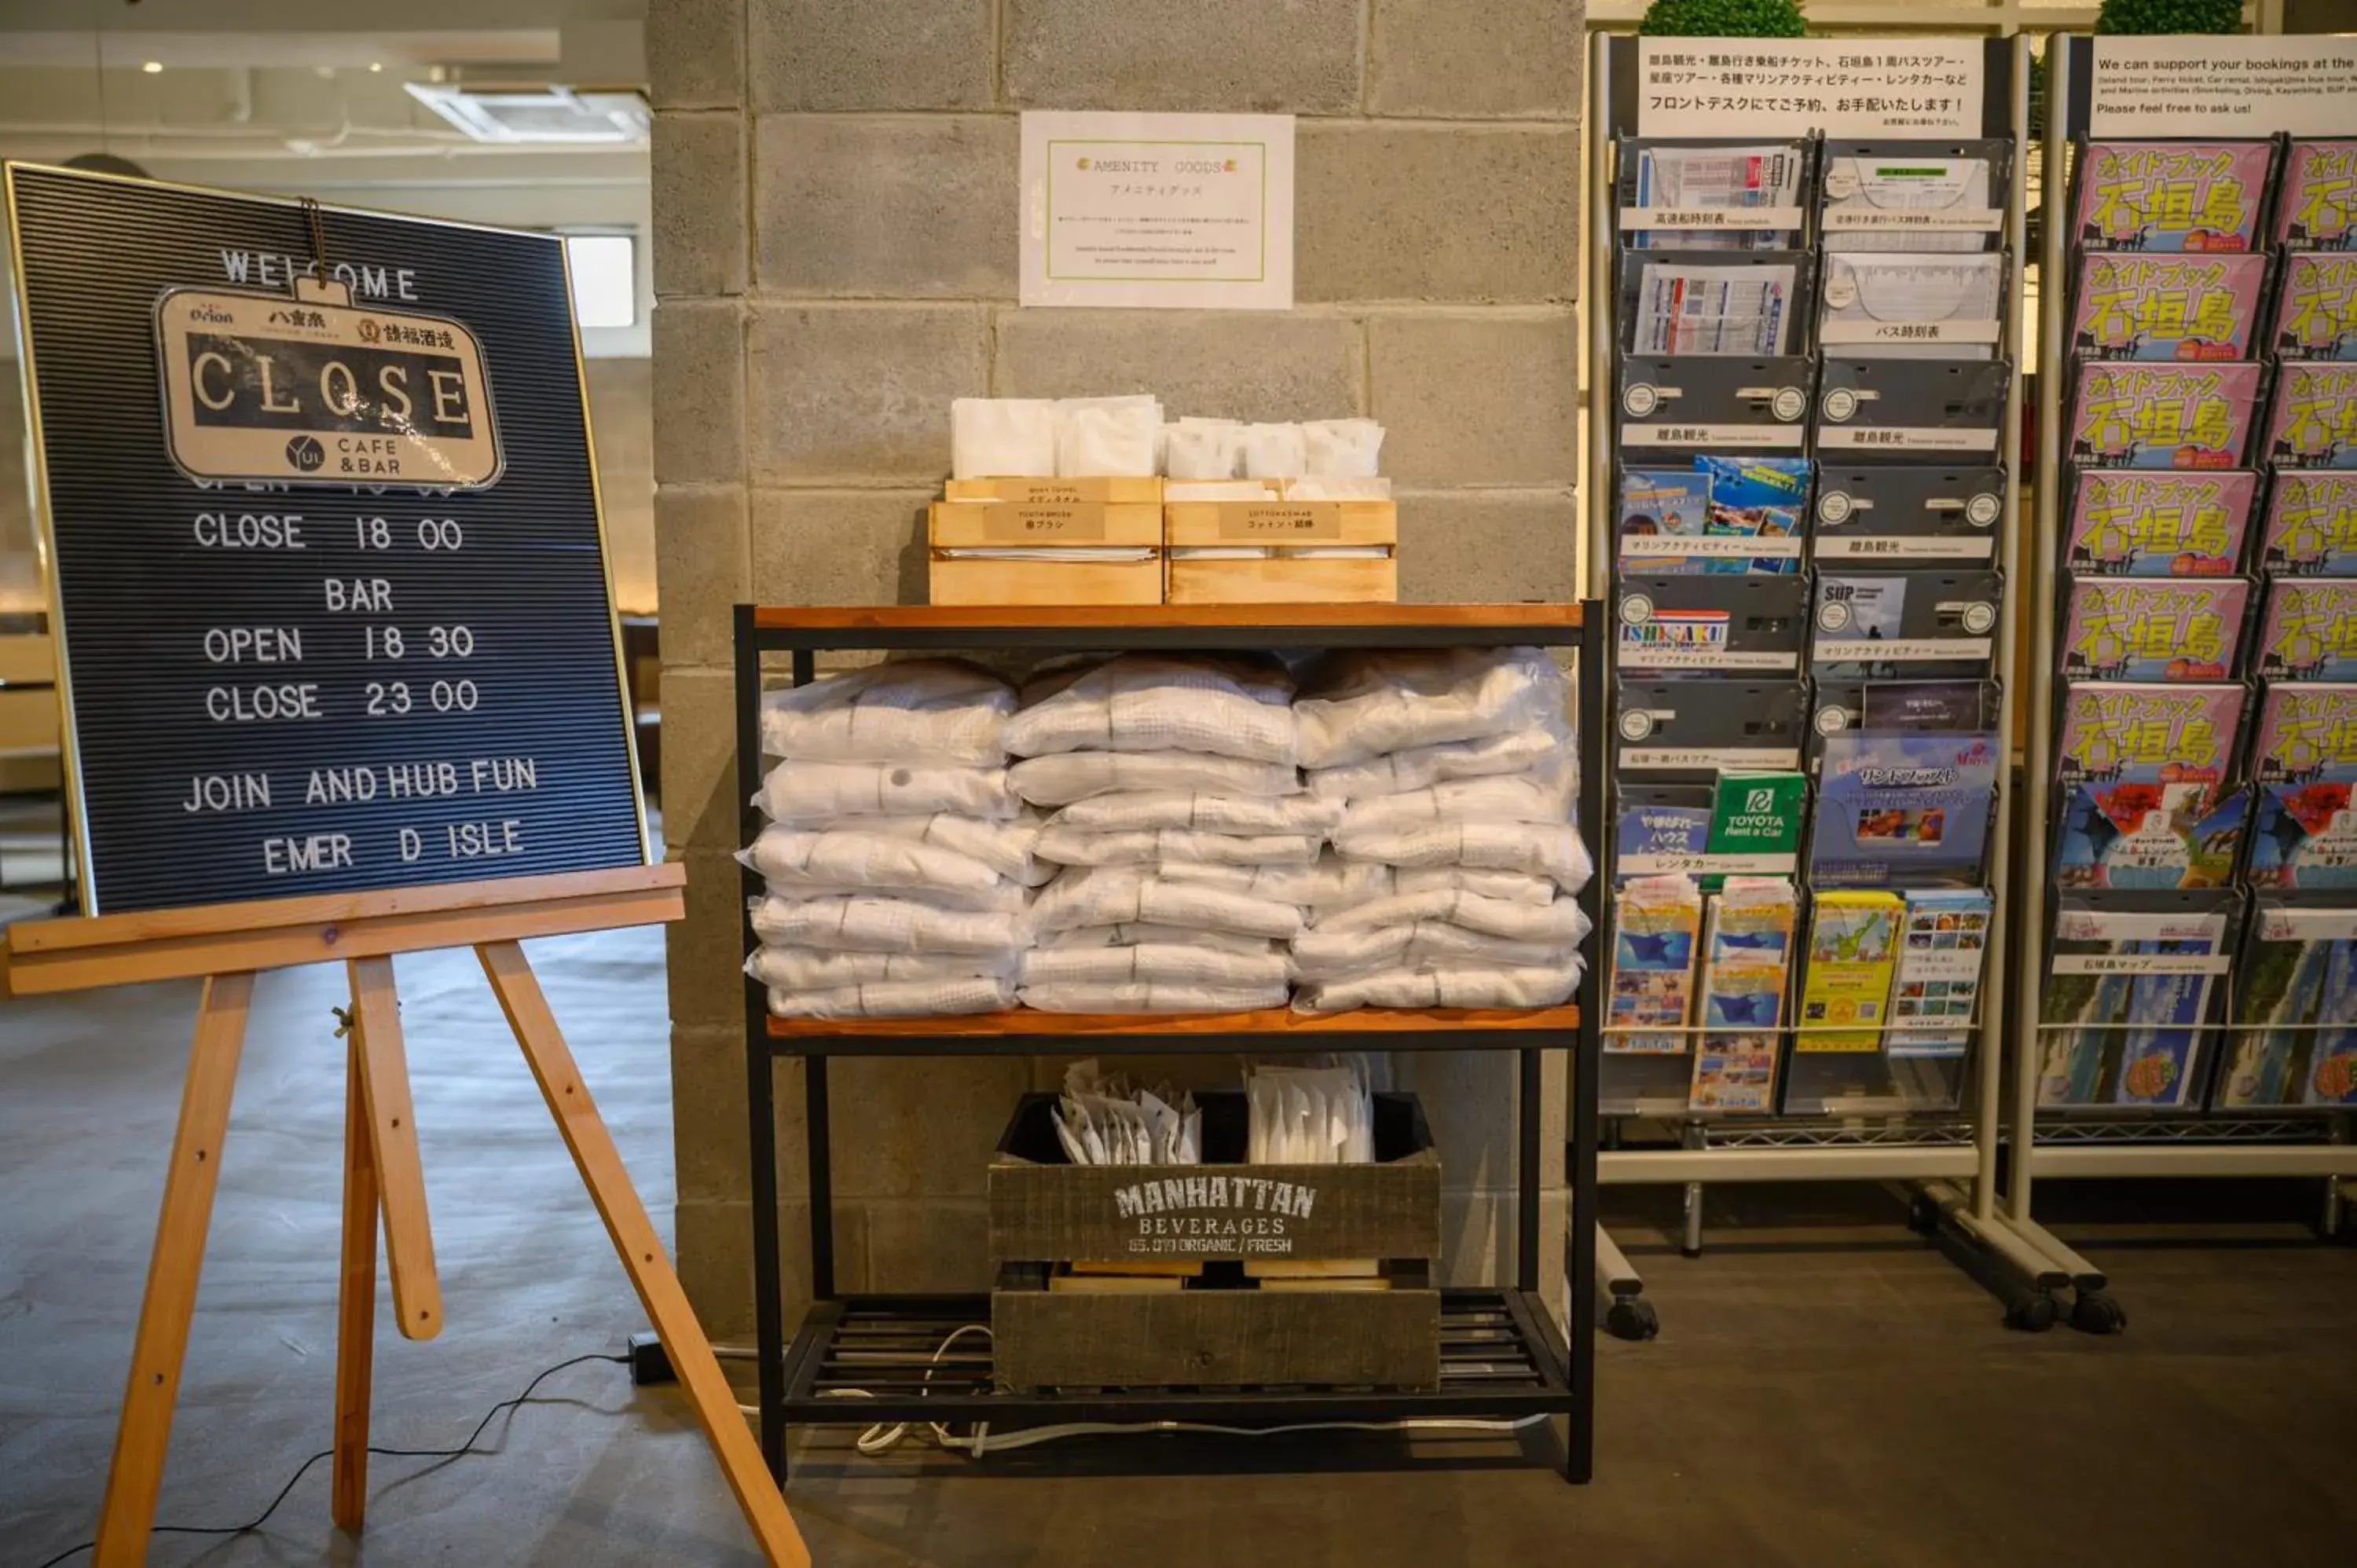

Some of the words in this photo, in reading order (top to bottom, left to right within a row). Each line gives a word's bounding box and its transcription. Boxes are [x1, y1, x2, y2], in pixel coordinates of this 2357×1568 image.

[2099, 59, 2119, 69] We
[2124, 60, 2148, 69] can
[2153, 58, 2207, 71] support
[2212, 60, 2241, 71] your
[2246, 57, 2308, 71] bookings
[2313, 58, 2326, 69] at
[2333, 57, 2354, 68] the
[2097, 103, 2135, 114] Please
[2140, 103, 2163, 114] feel
[2166, 103, 2191, 114] free
[2194, 104, 2207, 113] to
[2210, 103, 2230, 114] ask
[2233, 103, 2252, 114] us!
[2095, 149, 2234, 180] ガイドブック
[2092, 178, 2245, 235] 石垣島
[2088, 258, 2228, 290] ガイドブック
[2081, 286, 2237, 347] 石垣島
[192, 351, 470, 424] CLOSE
[2086, 370, 2223, 399] ガイドブック
[2079, 397, 2235, 453] 石垣島
[337, 438, 398, 456] CAFE
[340, 457, 401, 476] &BAR
[2085, 478, 2223, 507] ガイドブック
[194, 513, 306, 548] CLOSE
[356, 517, 391, 549] 18
[418, 518, 462, 550] 00
[2078, 504, 2233, 559] 石垣島
[324, 578, 393, 612] BAR
[2079, 585, 2215, 613] ガイドブック
[204, 628, 302, 663] OPEN
[365, 626, 405, 660] 18
[428, 625, 474, 658] 30
[2074, 610, 2225, 667] 石垣島
[206, 683, 322, 721] CLOSE
[365, 682, 412, 716] 23
[431, 680, 478, 713] 00
[2076, 691, 2209, 719] ガイドブック
[2069, 717, 2220, 770] 石垣島
[183, 773, 270, 812] JOIN
[306, 768, 376, 805] AND
[387, 762, 459, 798] HUB
[471, 757, 537, 793] FUN
[1725, 827, 1752, 837] Rent
[1762, 827, 1783, 837] Car
[1728, 815, 1784, 828] TOYOTA
[263, 833, 353, 874] EMER
[399, 828, 421, 863] D
[448, 819, 525, 858] ISLE
[1655, 858, 1717, 869] レンタカー
[1113, 1175, 1319, 1220] MANHATTAN
[1139, 1217, 1286, 1236] BEVERAGES
[1178, 1237, 1237, 1254] ORGANIC
[1247, 1238, 1292, 1254] FRESH
